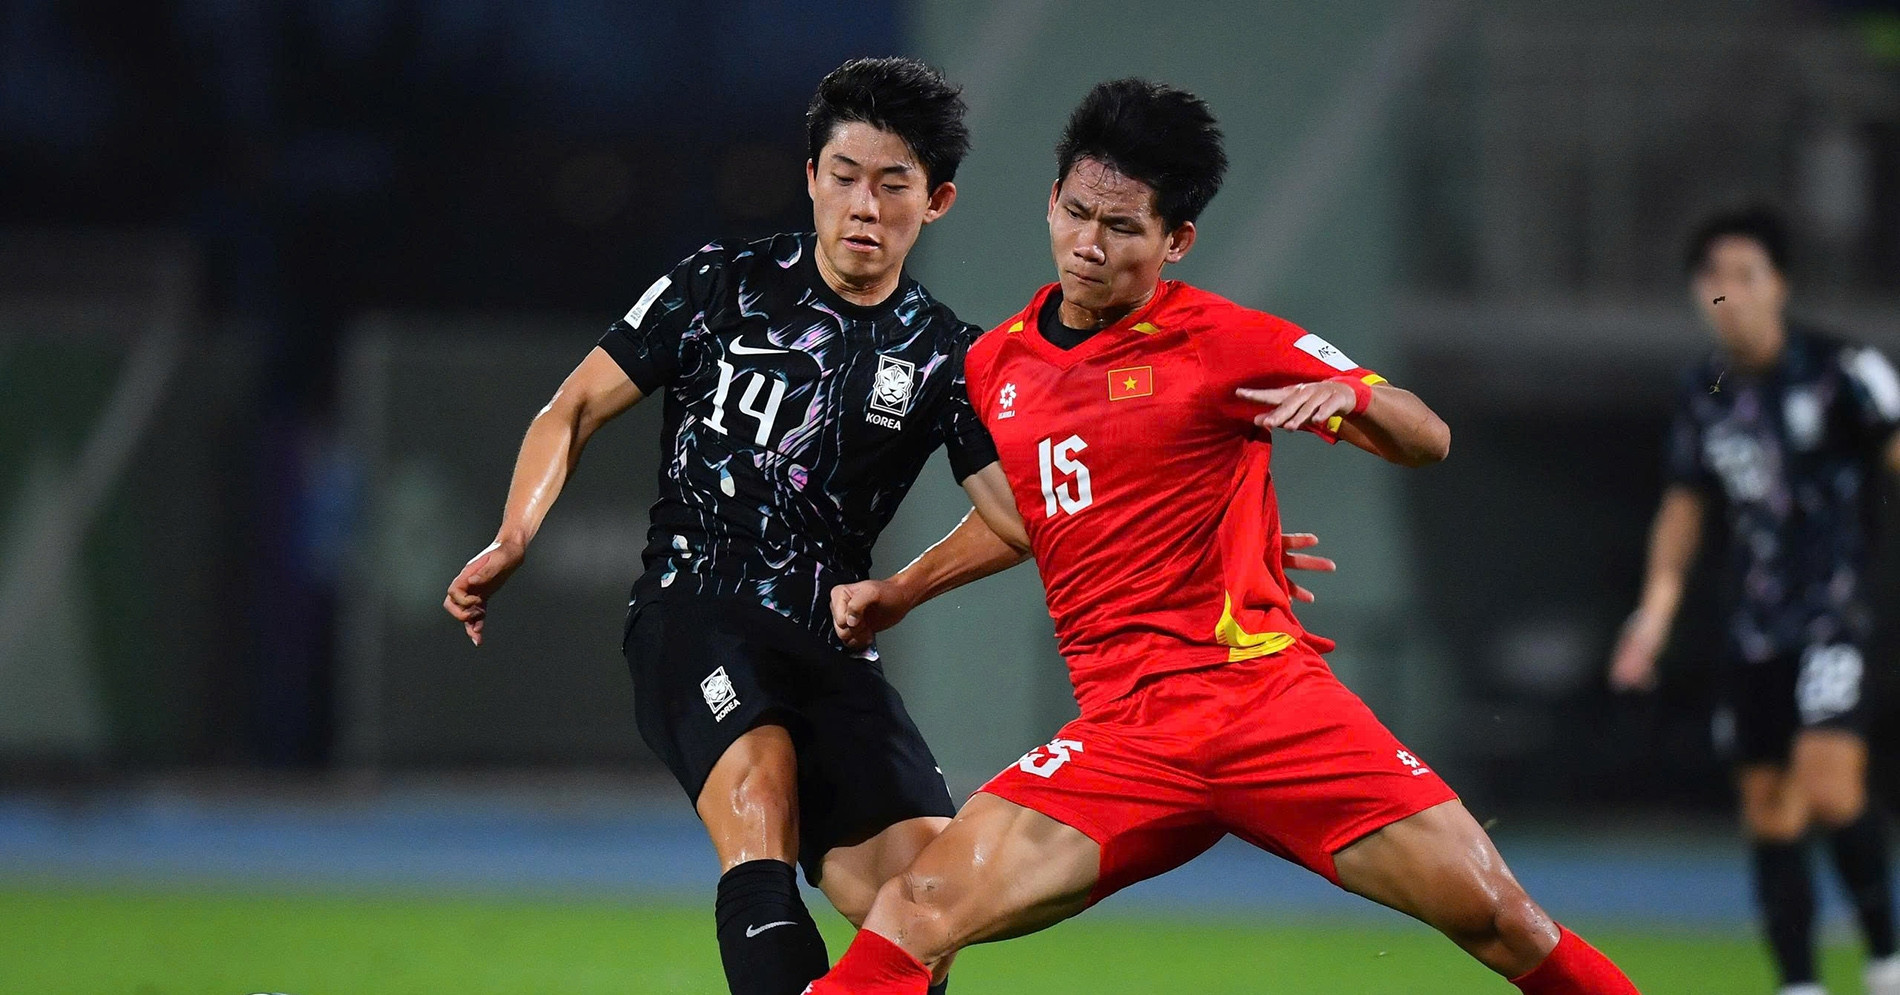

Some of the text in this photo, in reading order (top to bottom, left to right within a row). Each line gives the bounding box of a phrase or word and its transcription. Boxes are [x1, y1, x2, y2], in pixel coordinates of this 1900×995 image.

[701, 359, 786, 447] 14
[865, 412, 902, 431] KOREA
[1038, 434, 1093, 519] 15
[715, 698, 742, 723] KOREA
